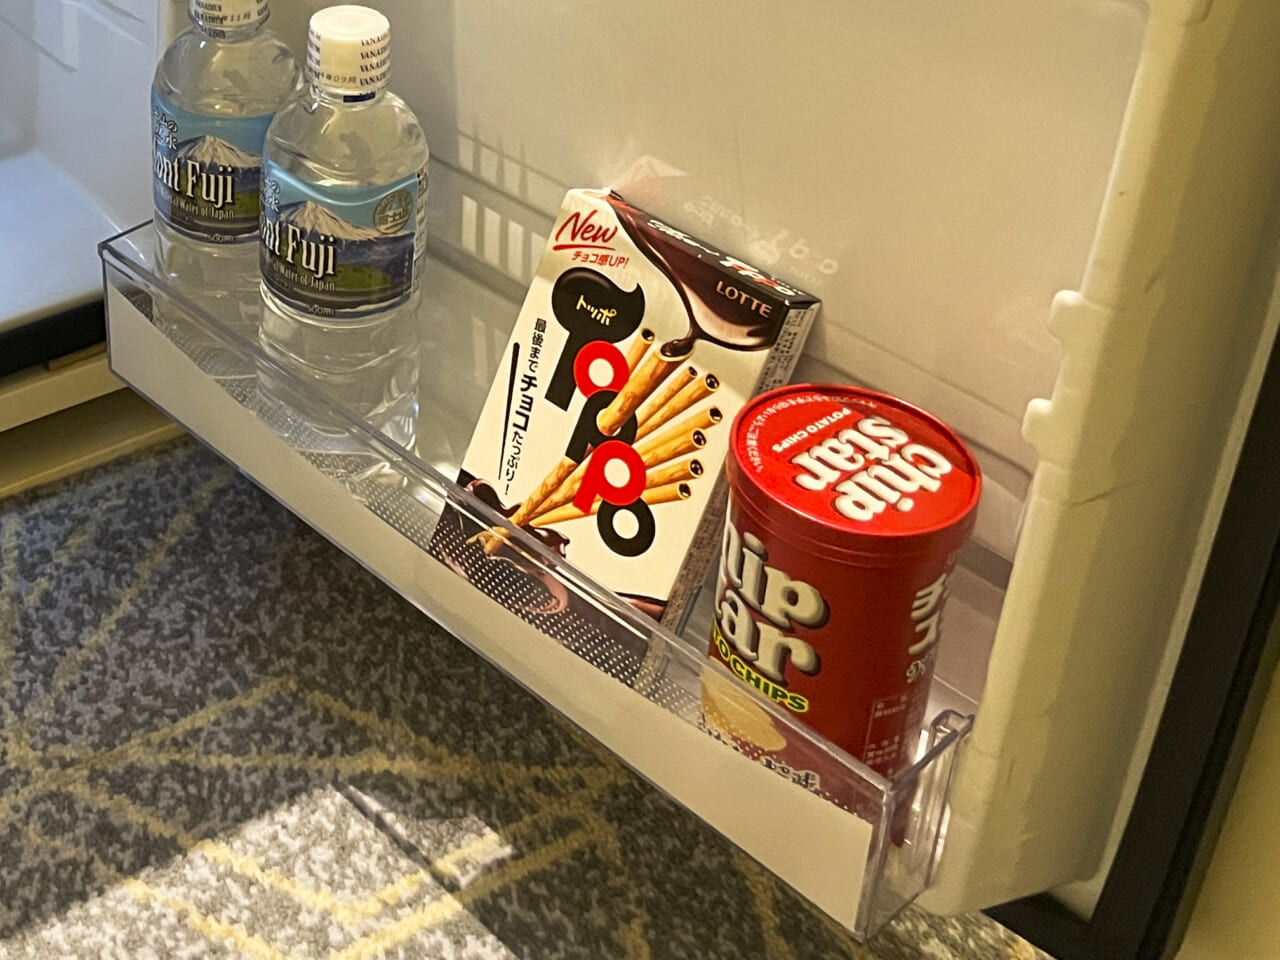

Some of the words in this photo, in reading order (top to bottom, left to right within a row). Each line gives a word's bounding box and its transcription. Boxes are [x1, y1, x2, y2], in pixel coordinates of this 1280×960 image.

[186, 159, 234, 209] Fuji
[211, 206, 234, 220] Japan
[555, 209, 618, 243] New
[286, 223, 336, 279] Fuji
[309, 277, 335, 292] Japan
[715, 280, 773, 318] LOTTE
[576, 294, 617, 326] トッポ
[806, 407, 852, 434] POTATO
[771, 428, 809, 453] CHIPS
[835, 443, 952, 521] Chip
[731, 655, 809, 713] CHIPS
